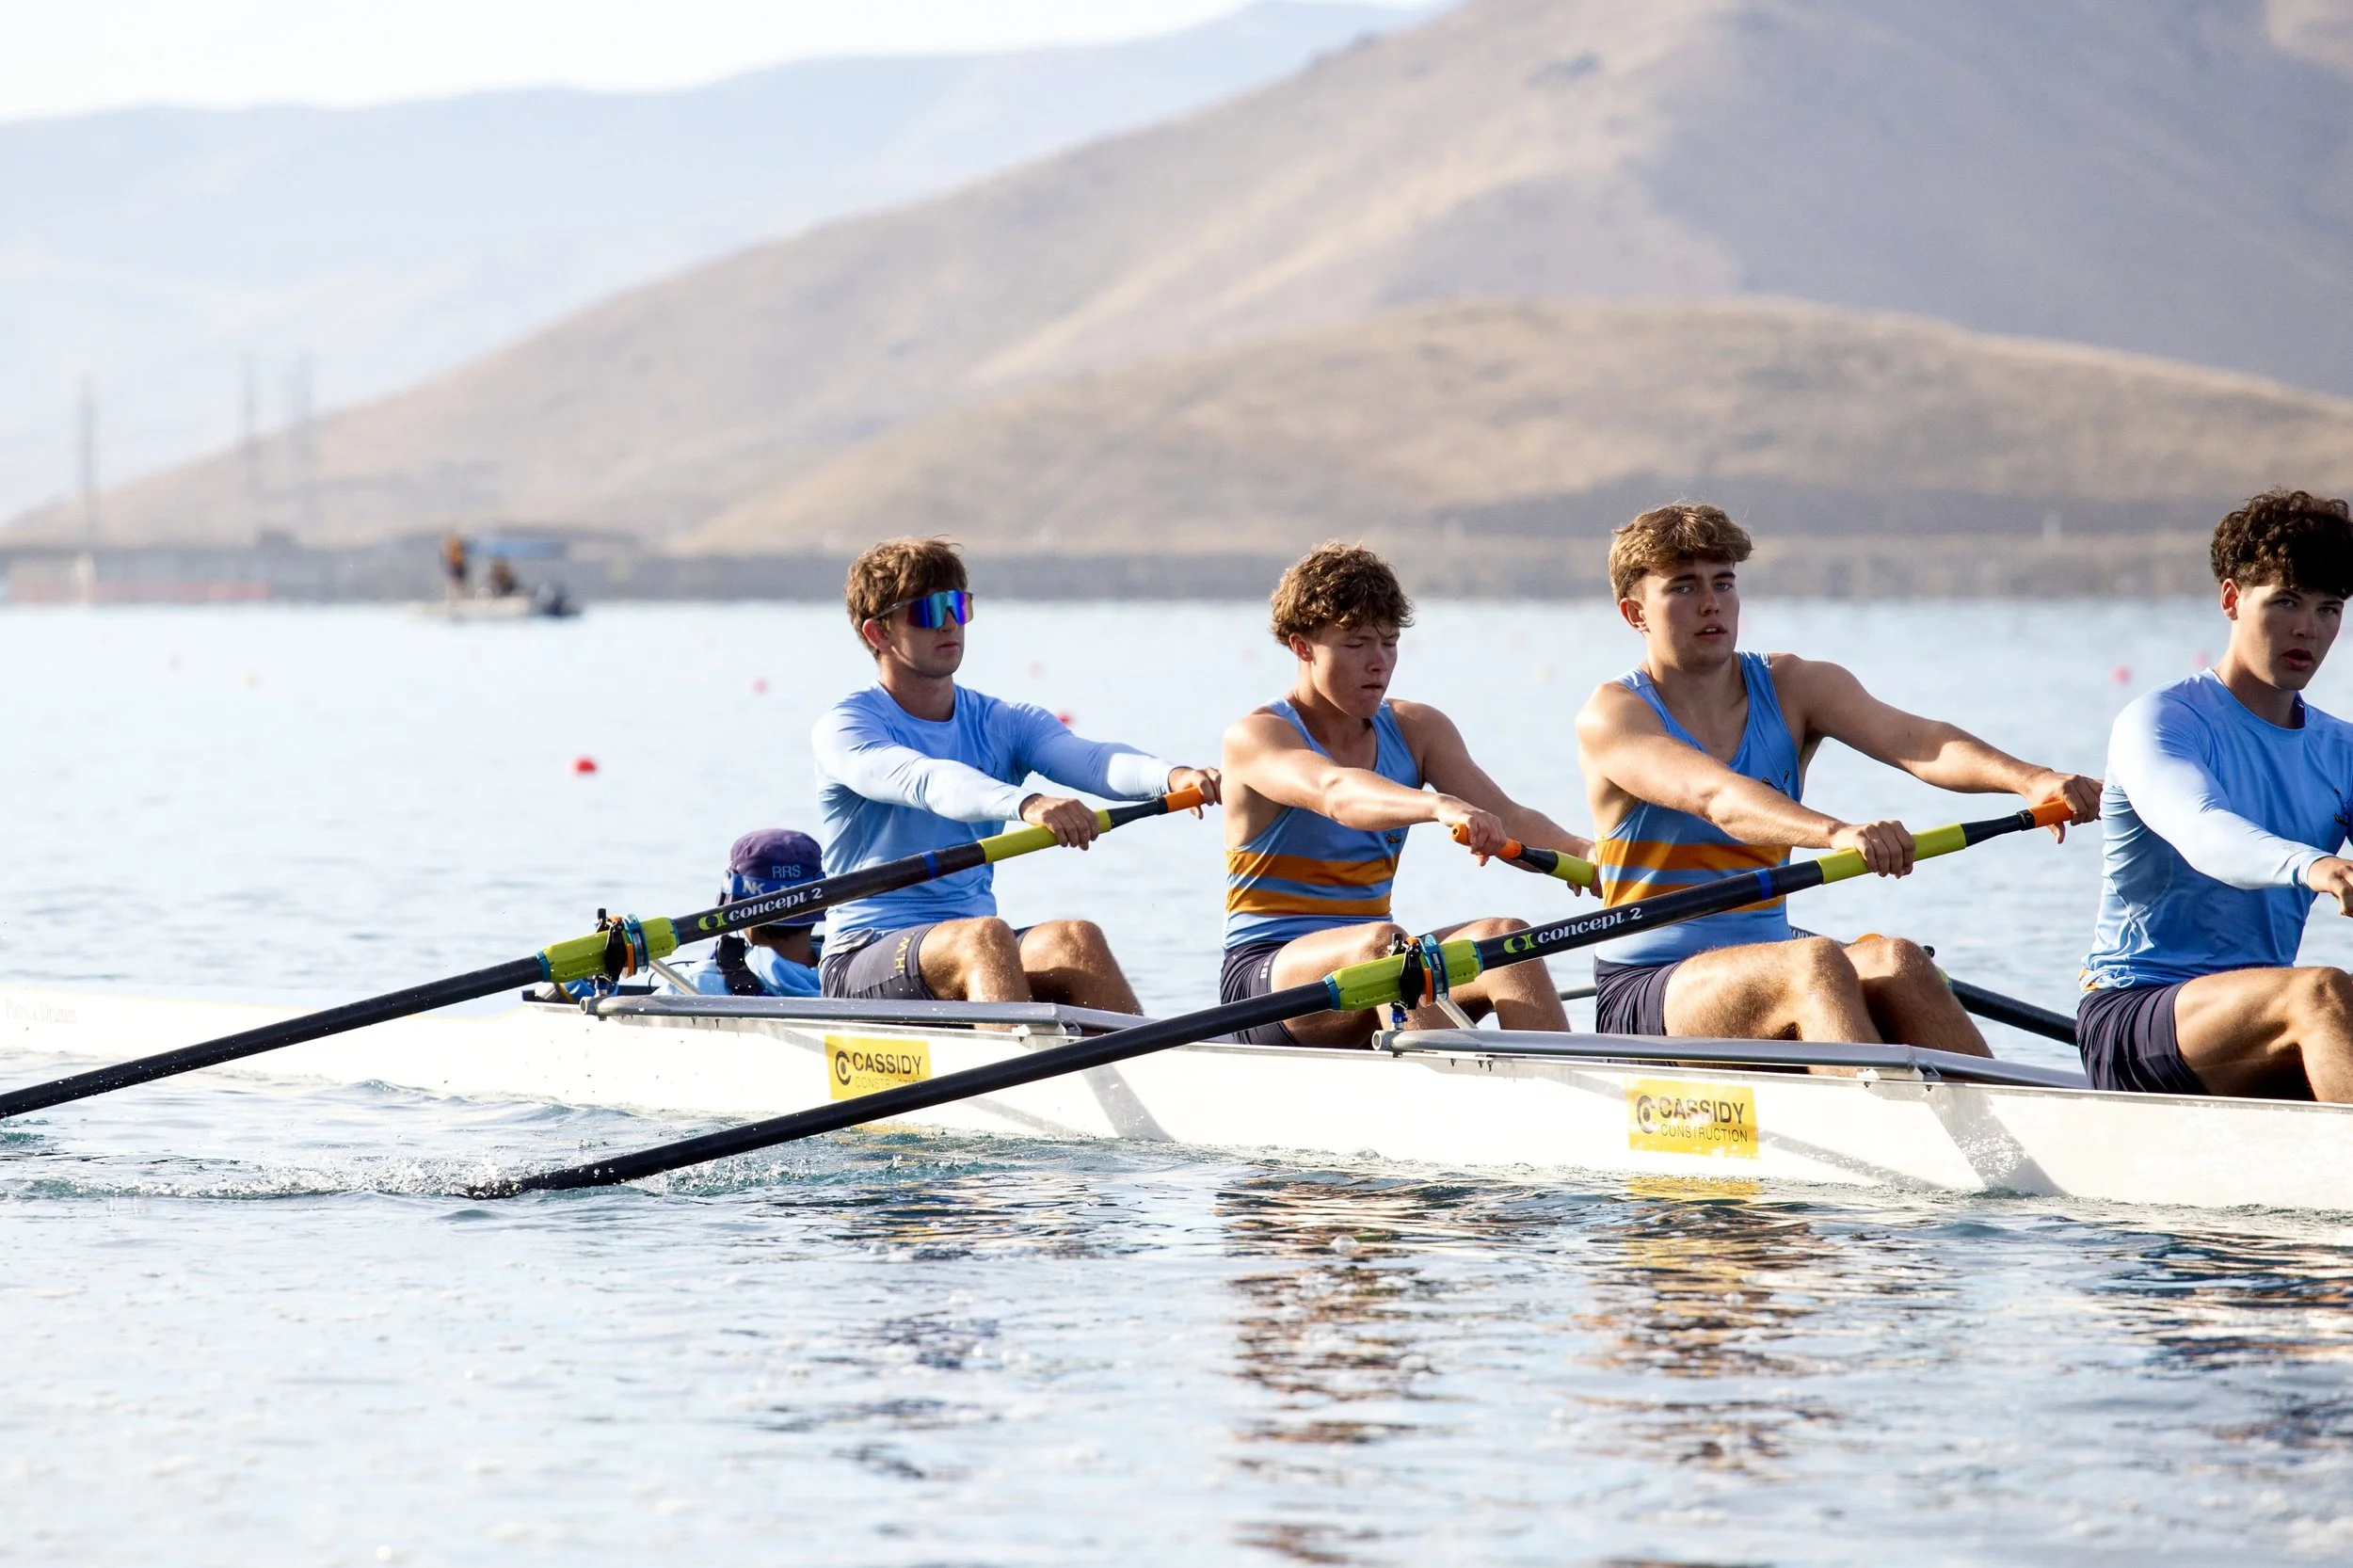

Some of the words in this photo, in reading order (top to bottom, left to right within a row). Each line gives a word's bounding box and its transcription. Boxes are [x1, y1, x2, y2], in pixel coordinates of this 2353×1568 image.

[772, 865, 801, 878] RRS
[728, 890, 807, 921] concept
[812, 888, 824, 900] 2
[1538, 911, 1624, 944] concept
[1630, 907, 1642, 920] 2
[852, 1051, 921, 1075] CASSIDY
[1658, 1096, 1744, 1124] CASSIDY
[1660, 1124, 1748, 1143] CONSTRUCTION
